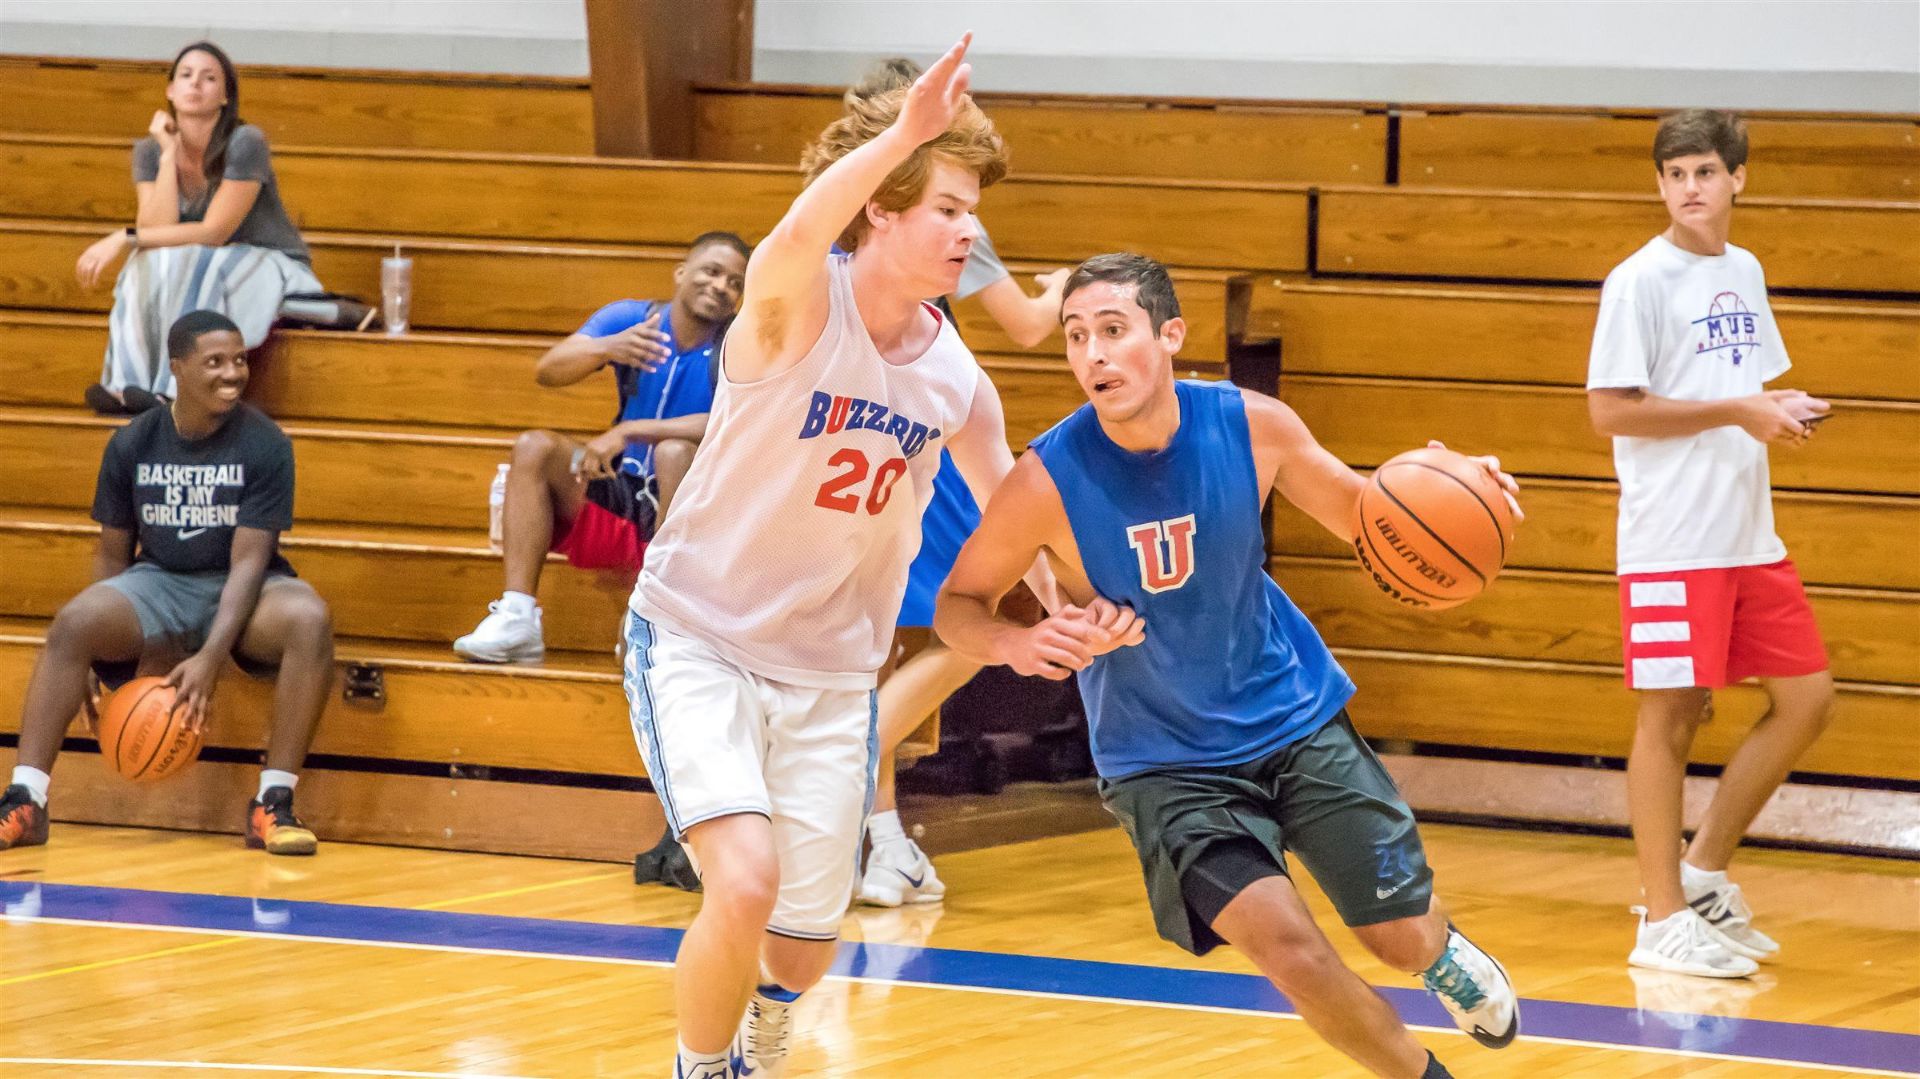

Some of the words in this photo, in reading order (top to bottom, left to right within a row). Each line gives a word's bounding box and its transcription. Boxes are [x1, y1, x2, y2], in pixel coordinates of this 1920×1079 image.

[137, 463, 244, 486] BASKETBALL
[165, 484, 183, 505] IS
[187, 485, 215, 505] MY
[814, 448, 907, 516] 20
[1126, 513, 1197, 594] U
[1375, 515, 1457, 589] EVOLUTION
